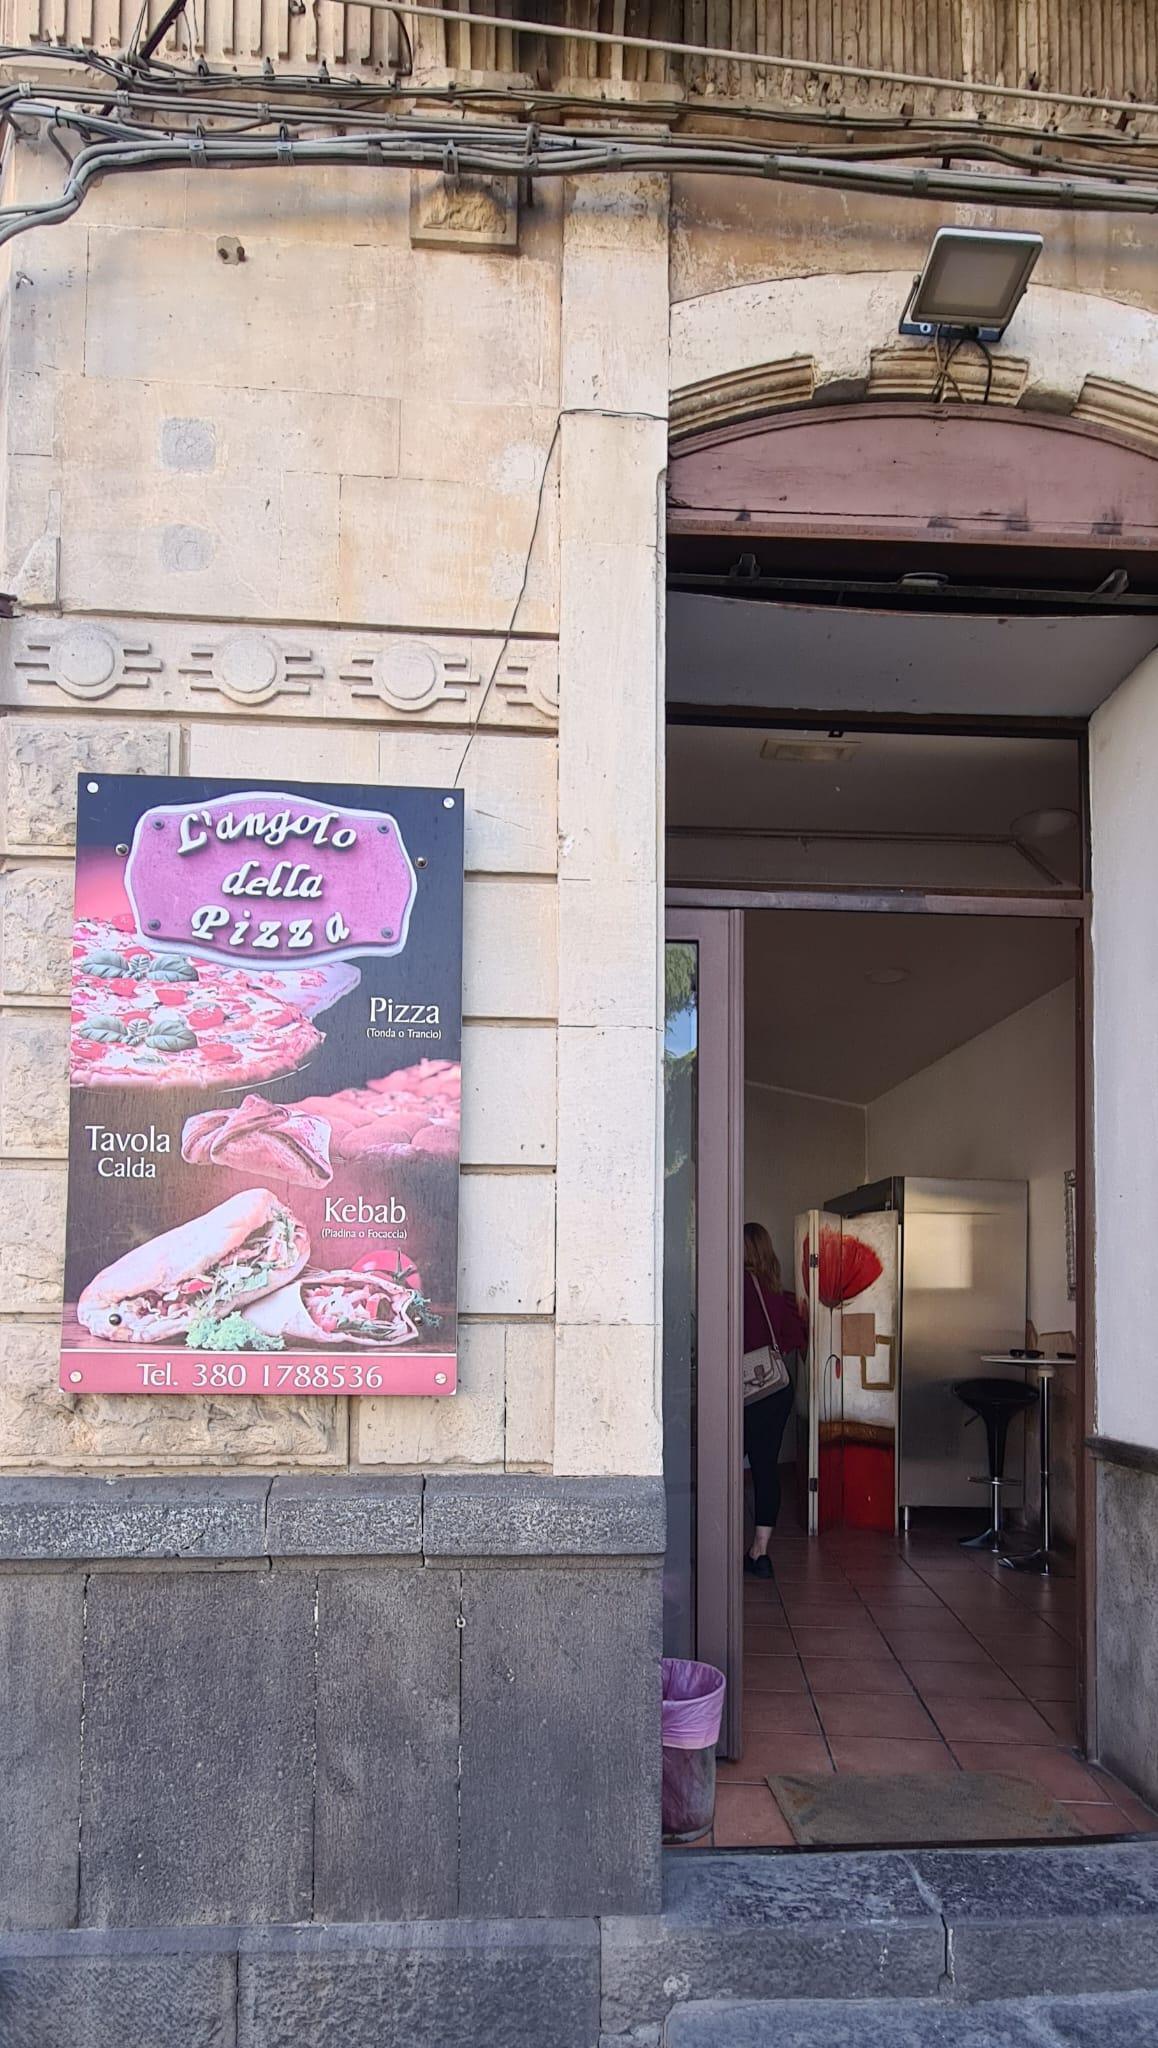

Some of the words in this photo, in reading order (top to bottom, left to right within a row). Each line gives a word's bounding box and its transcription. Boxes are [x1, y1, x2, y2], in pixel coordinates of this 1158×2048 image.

[177, 809, 357, 855] L'angolo
[222, 861, 322, 898] della
[191, 905, 349, 948] Pizza
[370, 997, 440, 1024] Pizza
[366, 1027, 396, 1038] (Tonda
[407, 1028, 442, 1039] Trancio)
[85, 1125, 171, 1153] Tavola
[97, 1157, 156, 1178] Calda
[325, 1196, 406, 1223] Kebab
[321, 1228, 356, 1238] (Piadina
[367, 1229, 407, 1239] Focaccia)
[136, 1363, 178, 1387] Tel.
[192, 1363, 247, 1388] 380
[262, 1363, 383, 1389] 1788536
